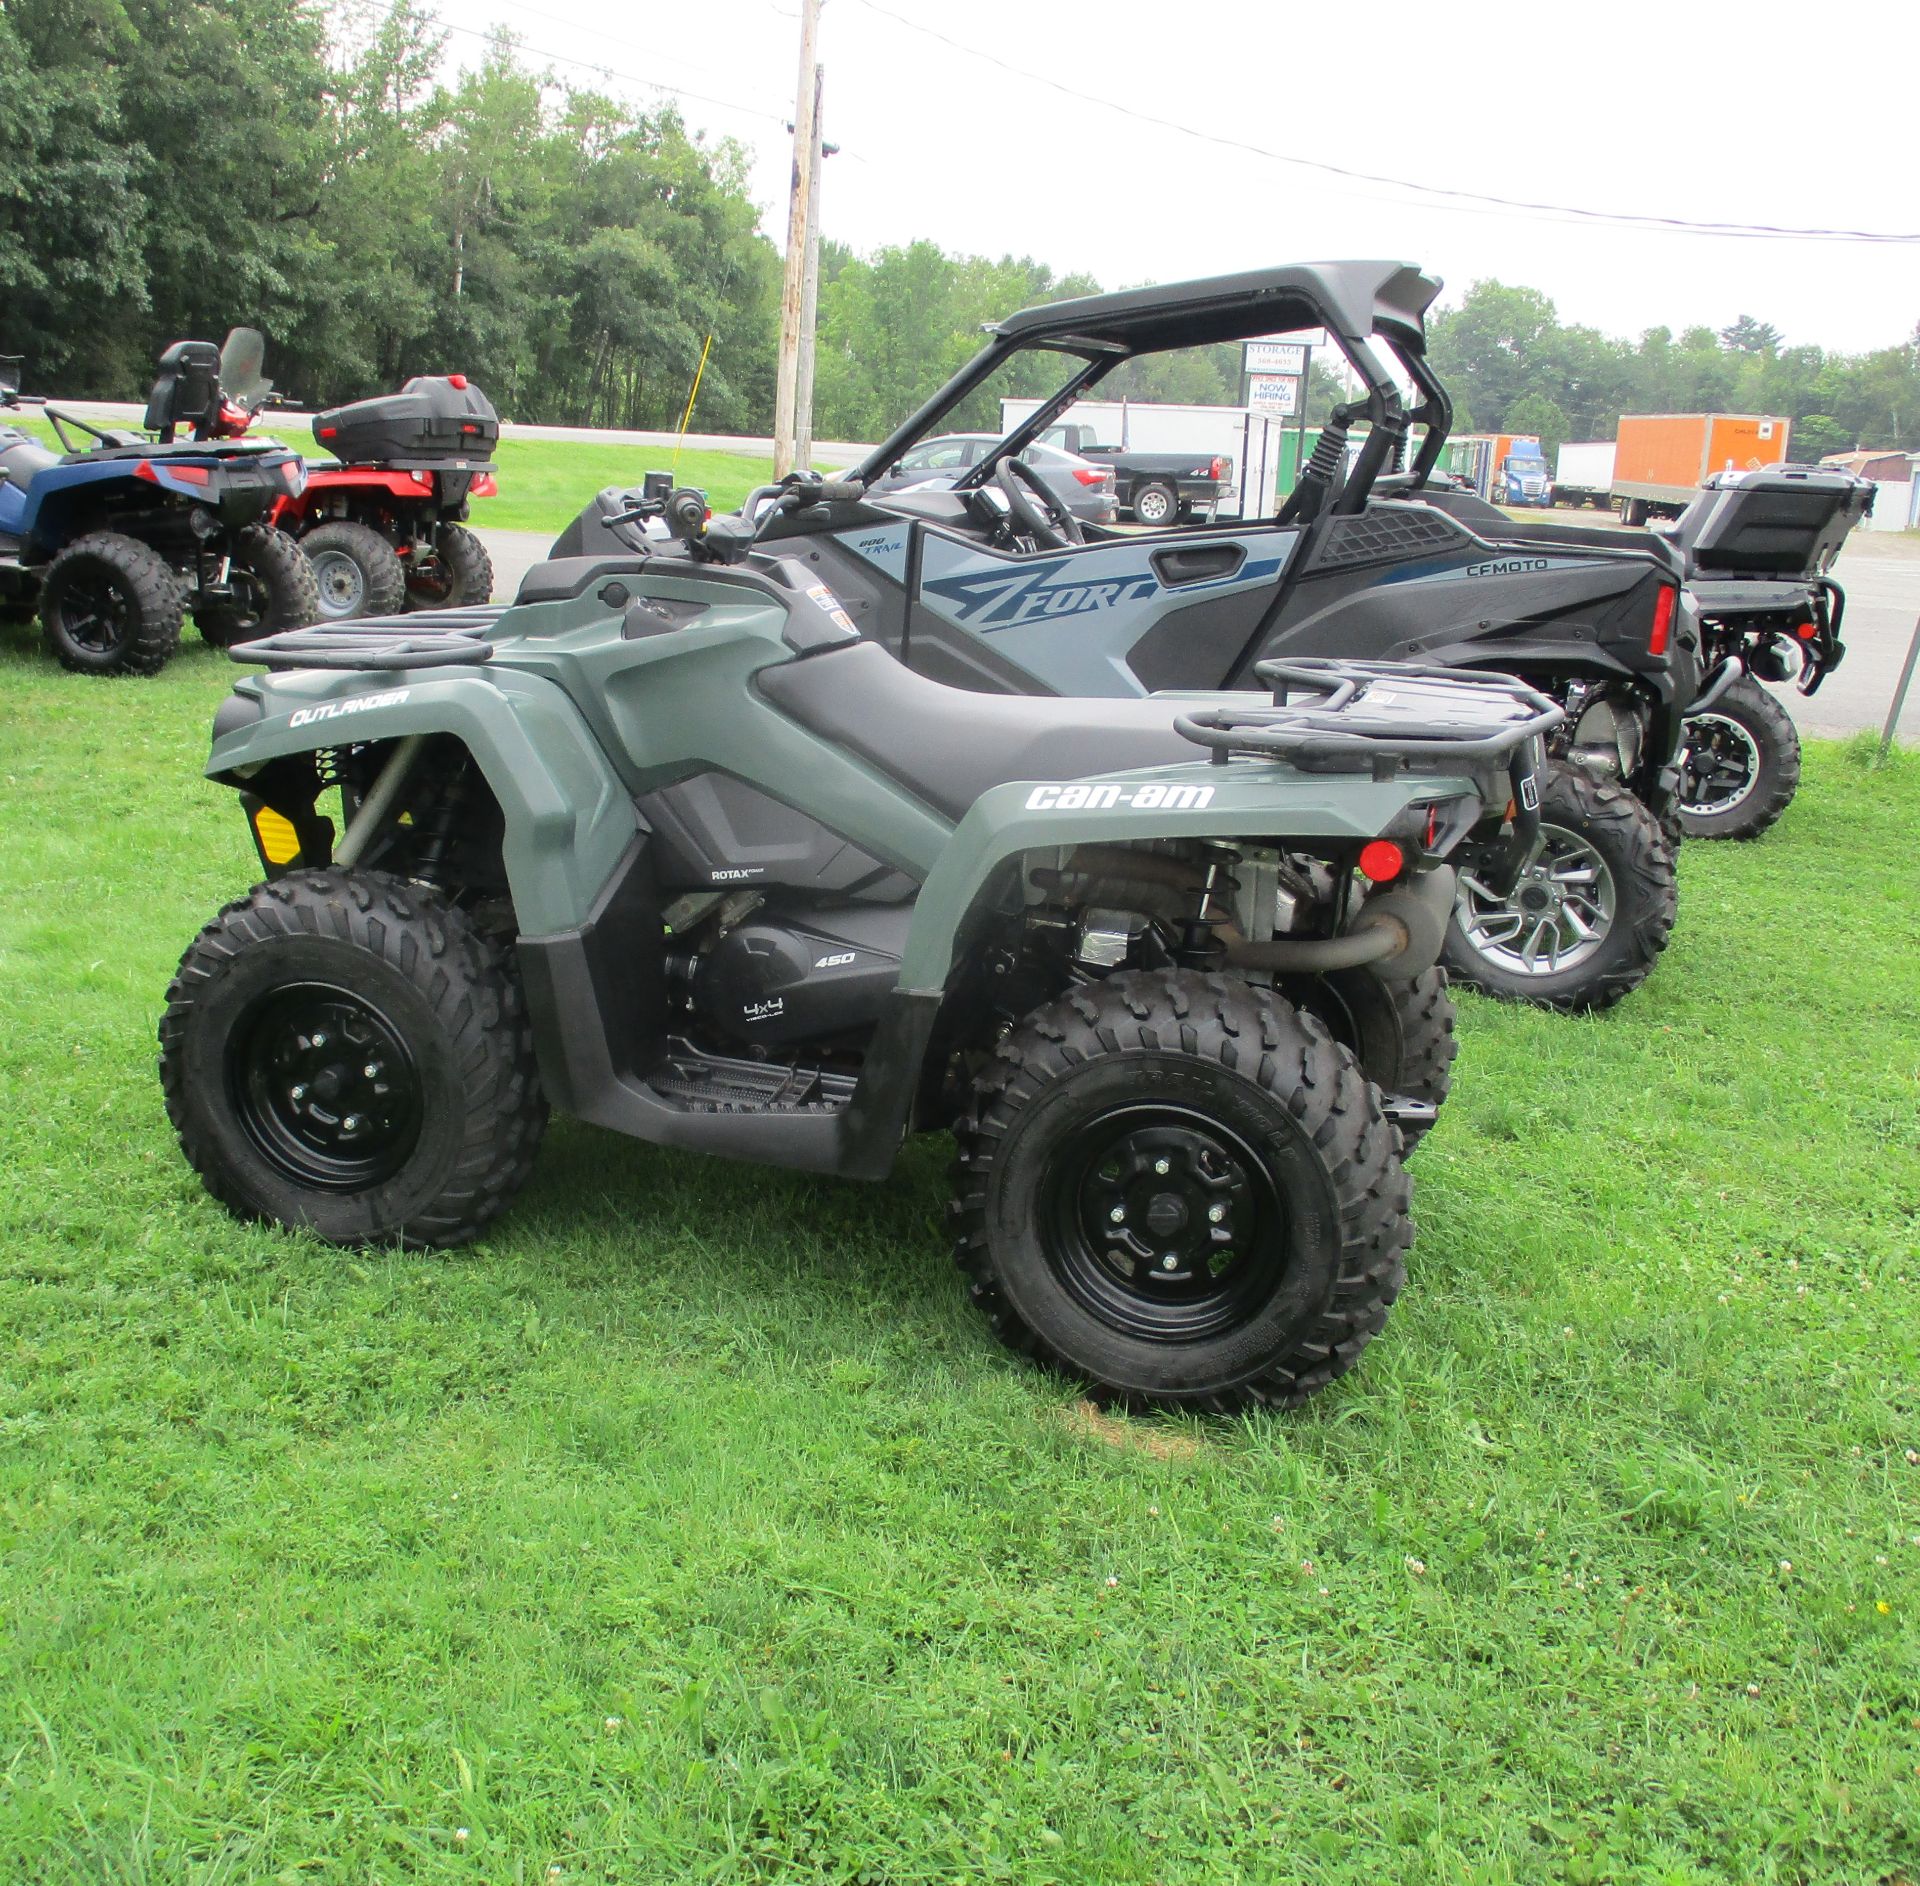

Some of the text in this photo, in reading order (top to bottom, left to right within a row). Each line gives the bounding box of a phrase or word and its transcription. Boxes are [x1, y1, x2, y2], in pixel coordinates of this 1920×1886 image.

[1249, 344, 1303, 355] STORAGE
[1259, 383, 1287, 392] NOW
[1254, 392, 1291, 401] HIRING
[864, 542, 904, 554] TRAIL
[1466, 559, 1548, 577] CFMOTO
[289, 690, 411, 729] OUTLANDER
[711, 868, 750, 881] ROTAX
[814, 952, 857, 969] 450
